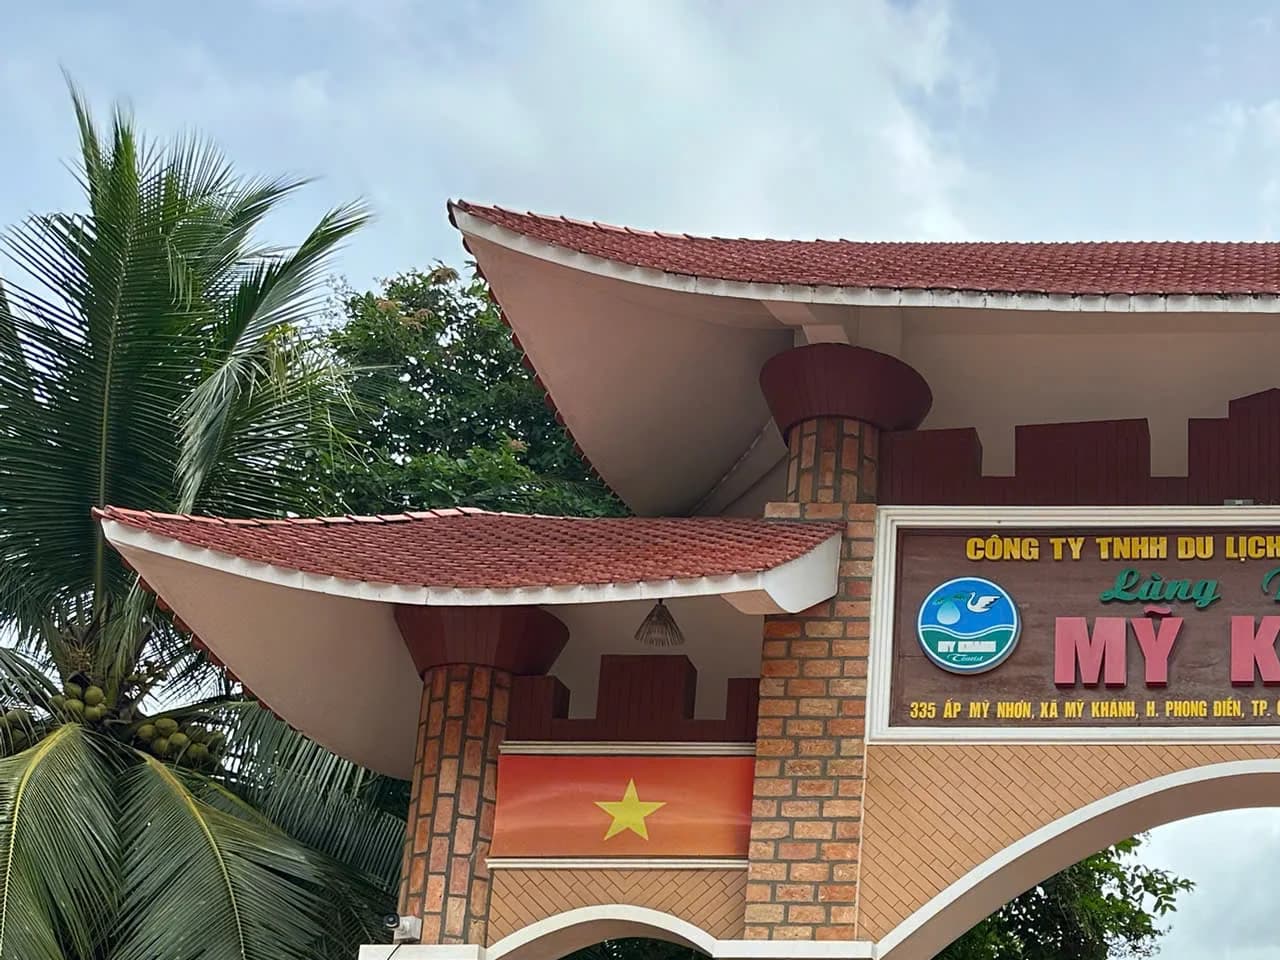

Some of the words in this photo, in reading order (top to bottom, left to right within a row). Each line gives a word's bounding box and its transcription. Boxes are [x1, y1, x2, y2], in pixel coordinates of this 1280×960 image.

[966, 534, 1040, 560] CÔNG
[1050, 537, 1085, 560] TY
[1096, 536, 1168, 560] TNHH
[1177, 536, 1214, 559] DU
[1100, 568, 1221, 608] Làng
[1054, 604, 1184, 689] MỸ
[910, 702, 936, 719] 335
[1146, 700, 1159, 718] H.
[1165, 700, 1208, 718] PHONG
[1251, 700, 1271, 718] TP.
